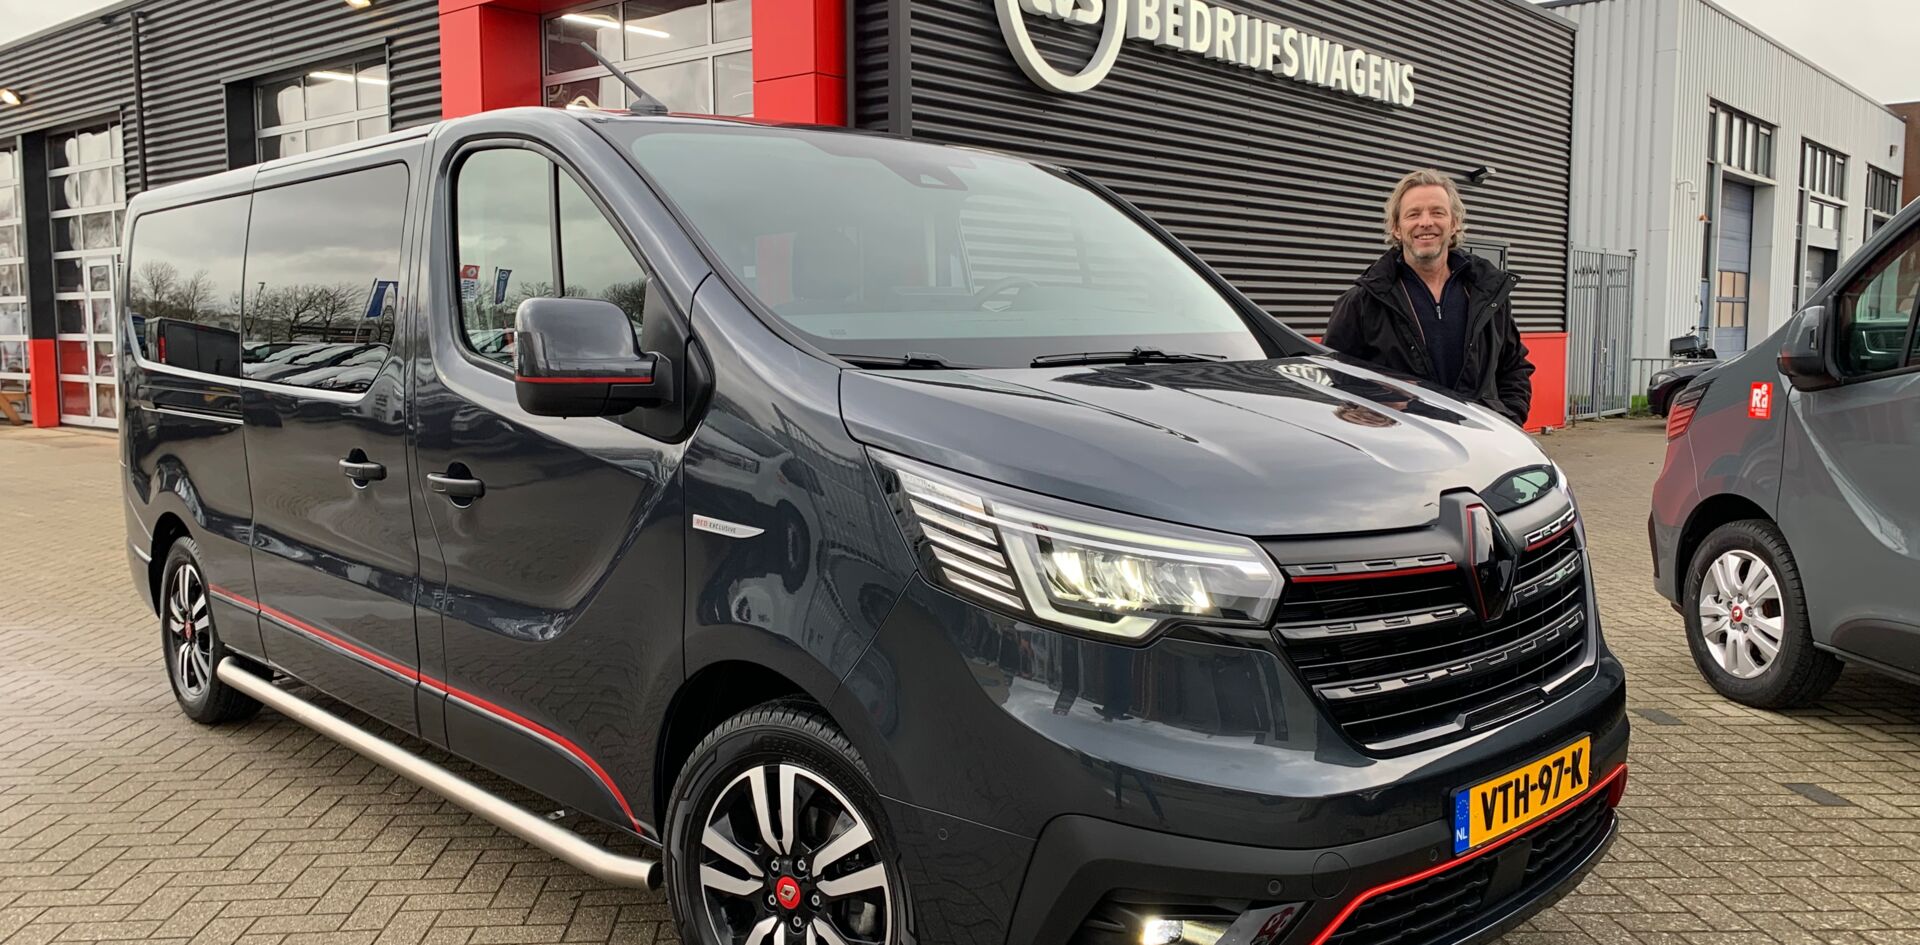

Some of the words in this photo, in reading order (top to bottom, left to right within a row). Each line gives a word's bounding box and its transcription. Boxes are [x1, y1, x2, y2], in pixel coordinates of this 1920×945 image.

[1128, 0, 1415, 107] BEDRIJFSWAGENS
[696, 519, 708, 527] RED
[1481, 747, 1583, 831] VTH-97-K
[1456, 827, 1468, 842] NL
